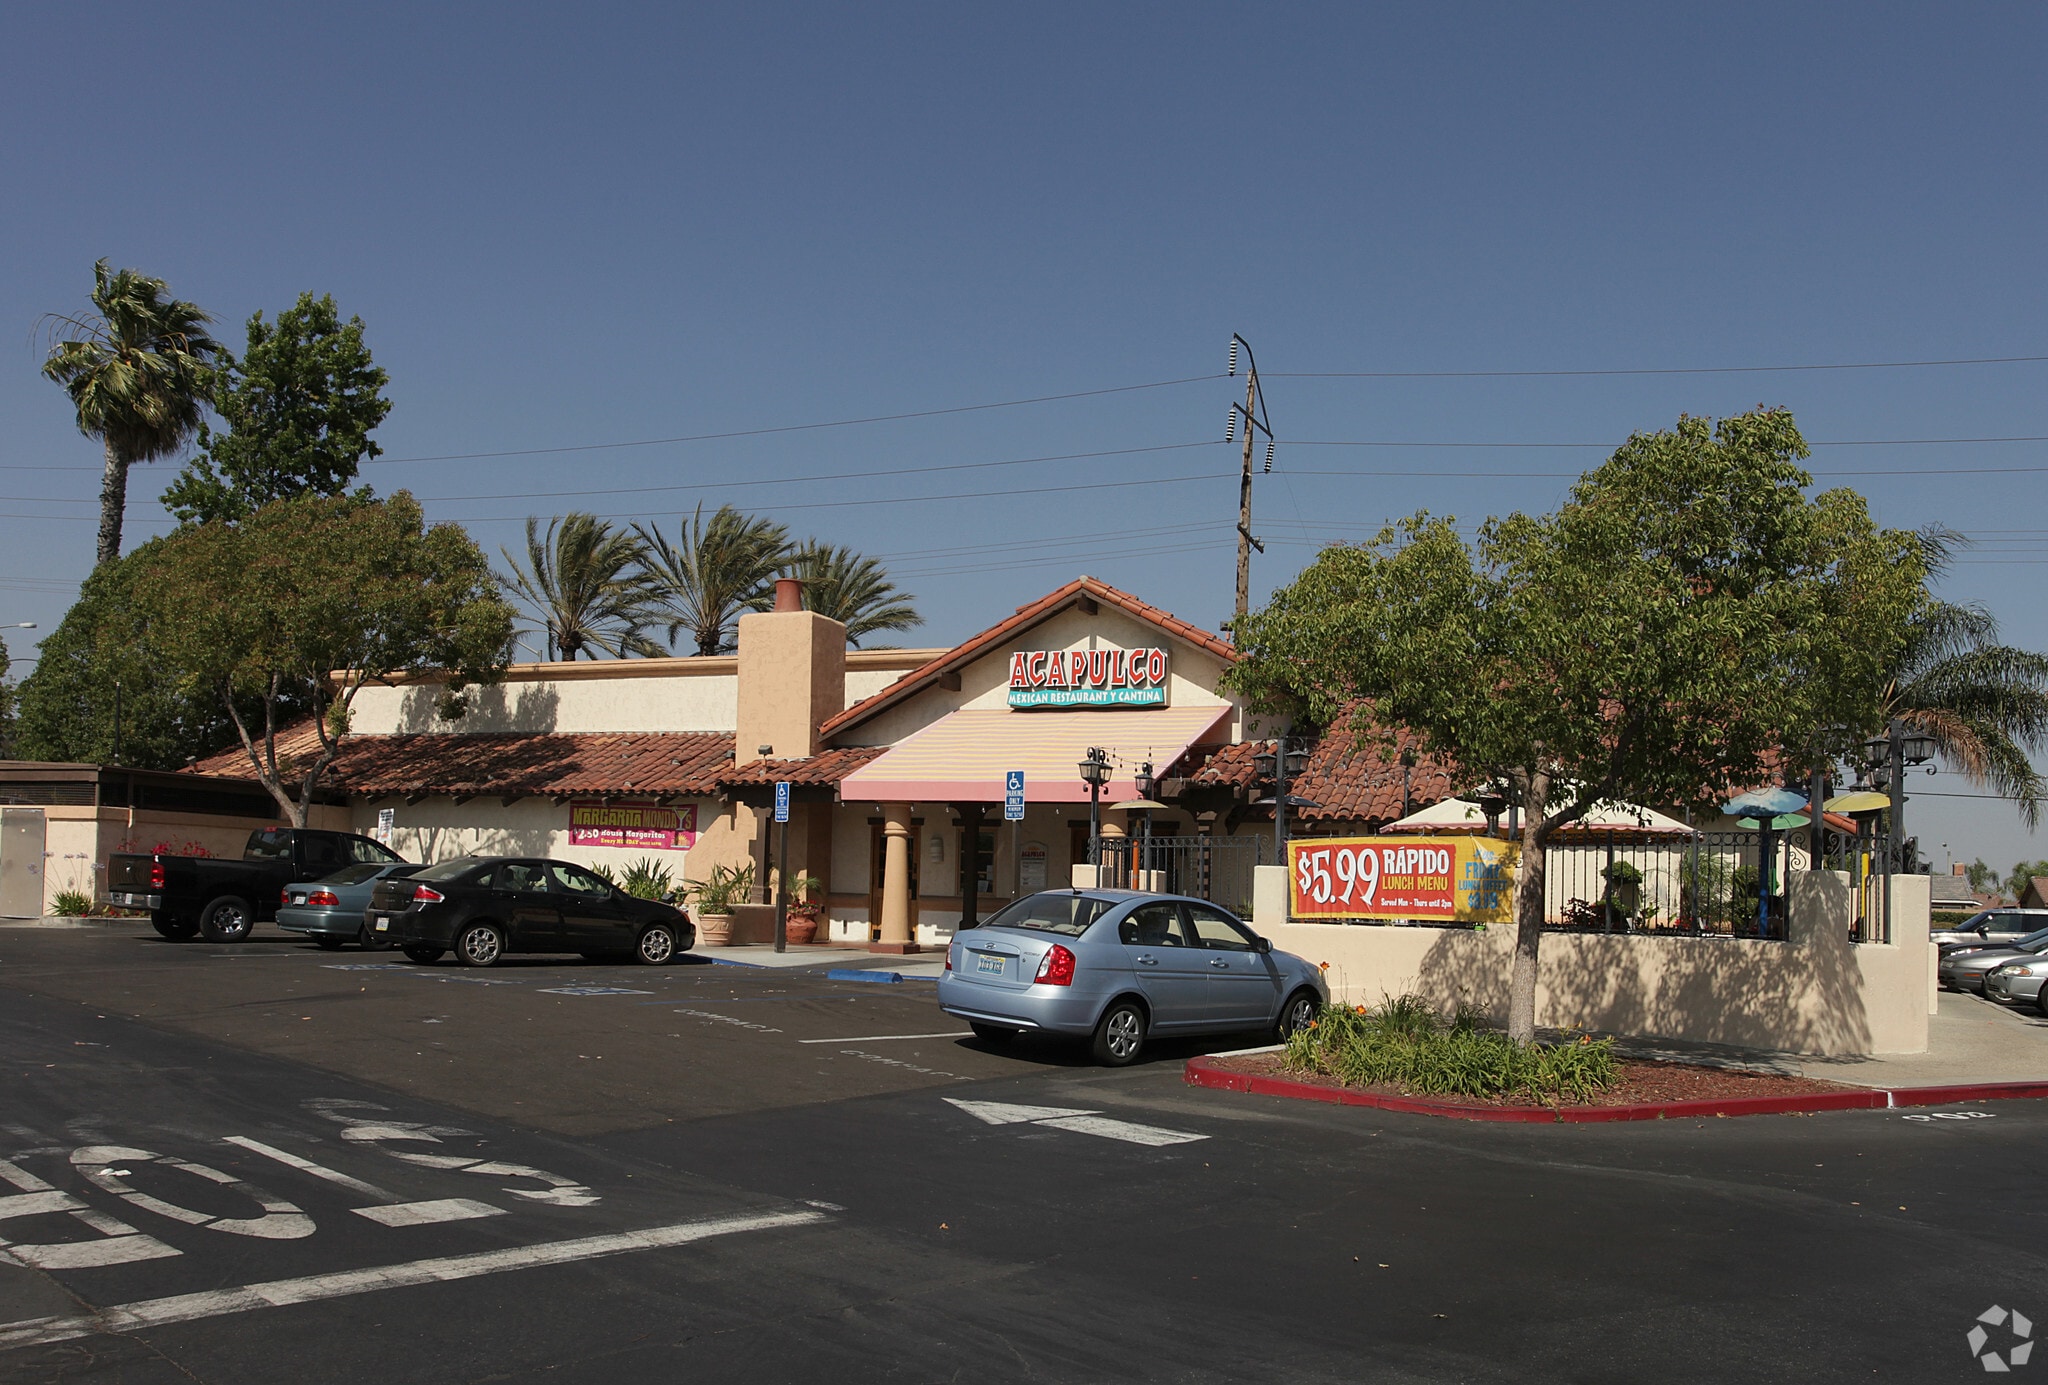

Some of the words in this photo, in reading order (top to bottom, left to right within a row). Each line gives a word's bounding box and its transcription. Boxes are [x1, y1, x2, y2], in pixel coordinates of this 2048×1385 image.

[1009, 647, 1166, 688] ACAPULCO
[1008, 694, 1048, 704] MEXICAN
[1050, 692, 1108, 703] RESTAURANT
[1110, 691, 1117, 701] Y
[1118, 691, 1161, 702] CANTINA
[573, 807, 642, 827] MARGARITA
[601, 829, 623, 837] House
[625, 830, 666, 840] Margaritas
[1383, 846, 1449, 875] RÁPIDO
[1298, 848, 1380, 906] $5.99
[1382, 876, 1414, 890] LUNCH
[1417, 876, 1448, 891] MENU
[1381, 898, 1397, 907] Served
[1398, 898, 1409, 907] Mon
[1414, 898, 1428, 907] Thurs
[1428, 899, 1440, 908] until
[1441, 899, 1452, 910] 2pm
[673, 1009, 783, 1032] COMPACT
[0, 1124, 602, 1270] STOP
